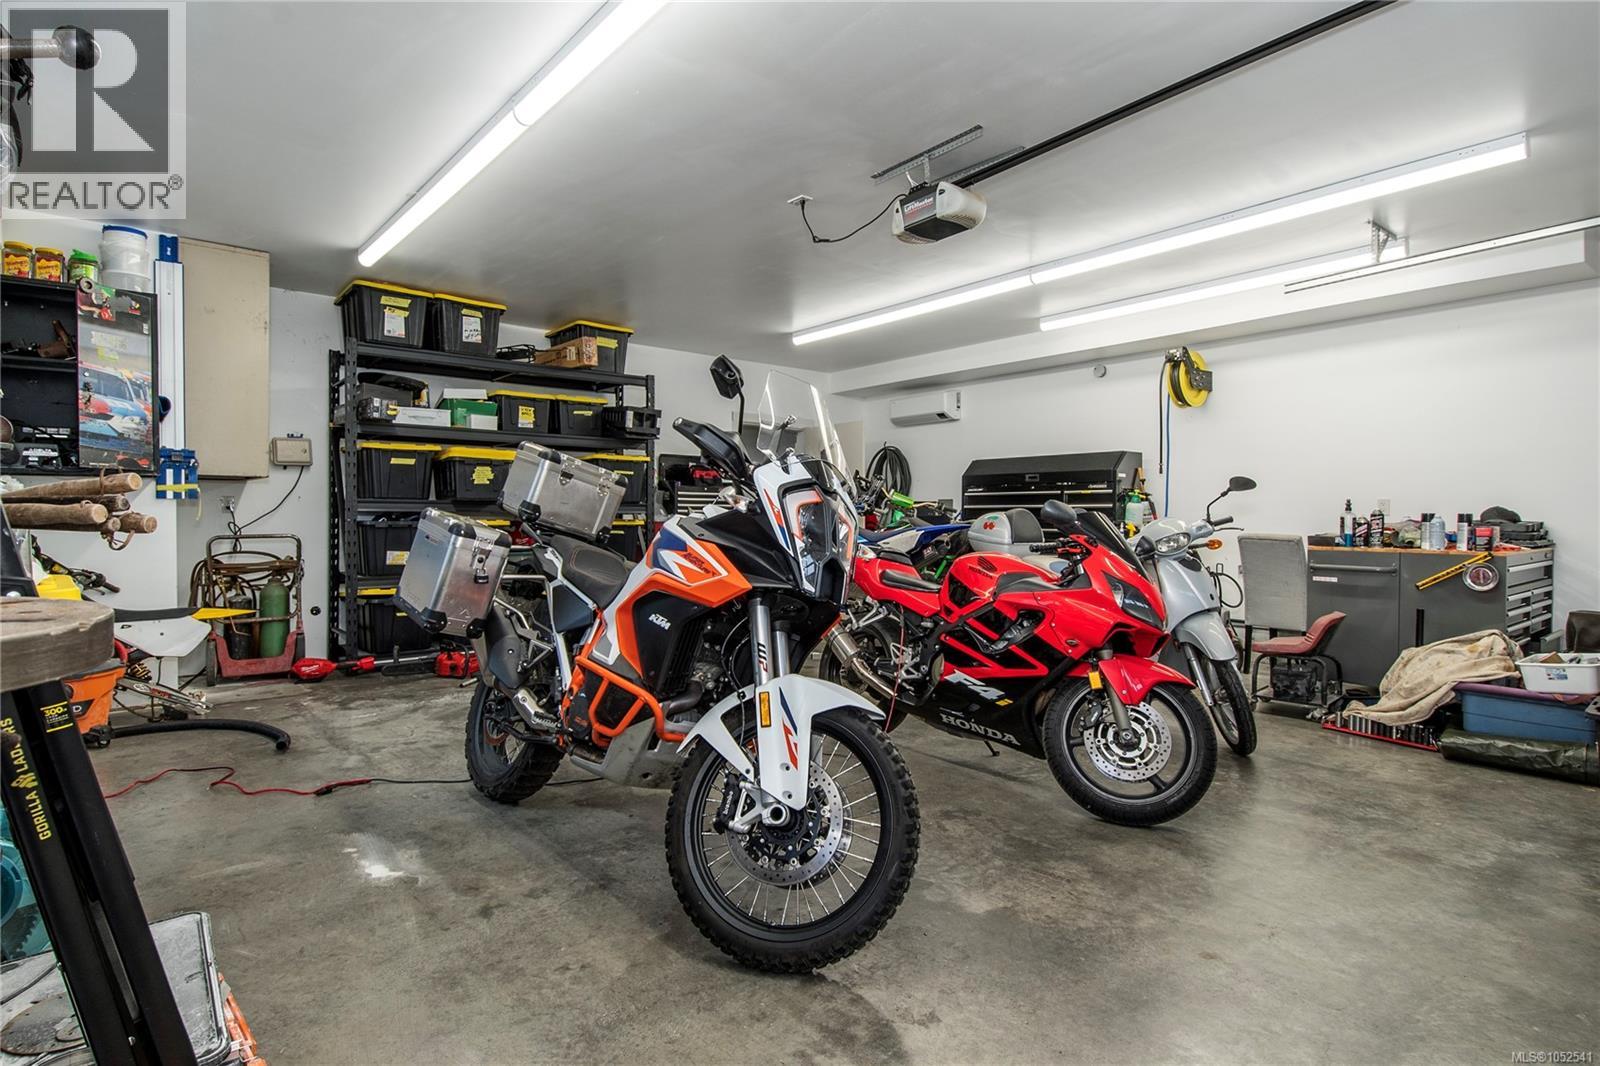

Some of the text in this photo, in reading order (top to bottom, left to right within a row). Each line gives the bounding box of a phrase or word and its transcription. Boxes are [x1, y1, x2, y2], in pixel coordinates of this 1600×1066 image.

[648, 613, 671, 630] KTM
[940, 713, 1021, 746] HONDA
[0, 718, 52, 841] GORILLA LADRS
